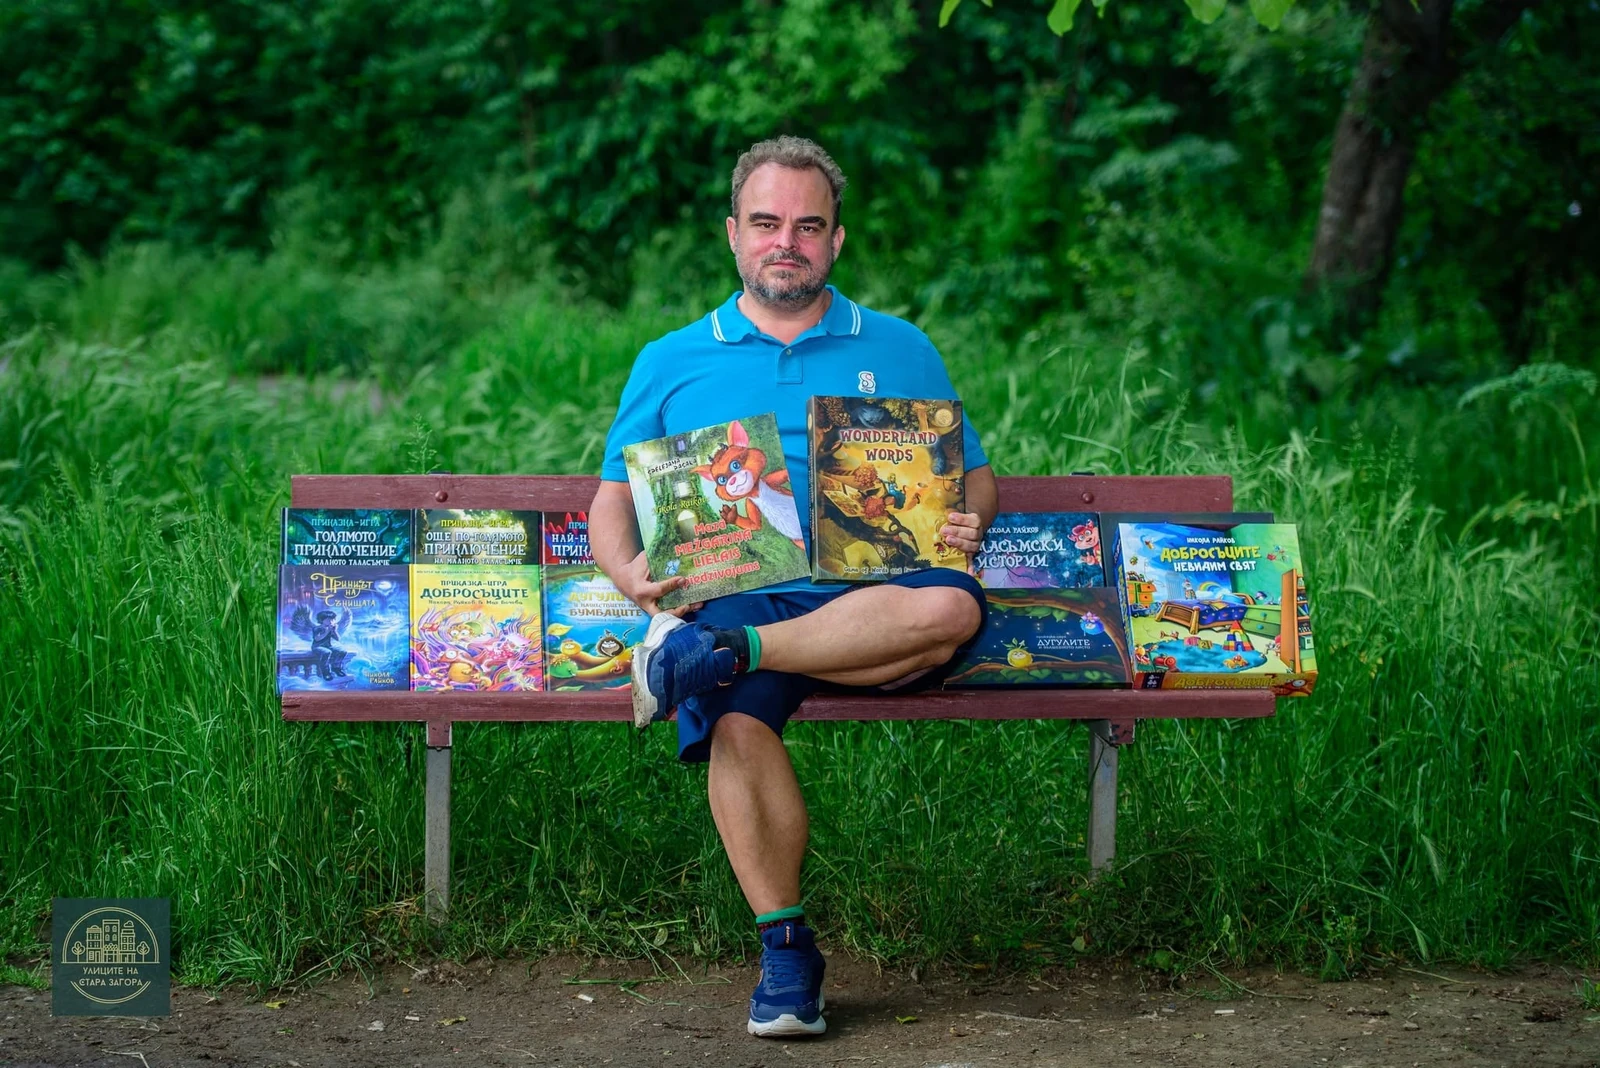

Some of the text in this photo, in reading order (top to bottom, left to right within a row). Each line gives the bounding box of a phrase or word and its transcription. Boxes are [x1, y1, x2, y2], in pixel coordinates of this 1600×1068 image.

[840, 429, 937, 446] WONDERLAND
[865, 448, 913, 464] WORDS
[311, 519, 380, 528] ПРИКАЗКА-ИГРА
[315, 531, 376, 544] ГОЛЯМОТО
[426, 532, 525, 544] ОЩЕ ПО-ГОЛЯМОТО
[294, 544, 397, 558] ПРИКЛЮЧЕНИЕ
[424, 543, 526, 557] ПРИКЛЮЧЕНИЕ
[979, 539, 1066, 553] ЛАСЪМСКИ
[693, 548, 741, 568] LIELAIS
[1160, 545, 1262, 562] ДОБРОСЪЦИТЕ
[975, 554, 1048, 568] ИСТОРИИ
[1174, 561, 1256, 572] НЕВИДИМ СВЯТ
[420, 588, 529, 600] ДОБРОСЪЦИТЕ
[568, 591, 625, 602] ДУГУЛИ
[569, 608, 642, 618] БУМБАЦИТЕ
